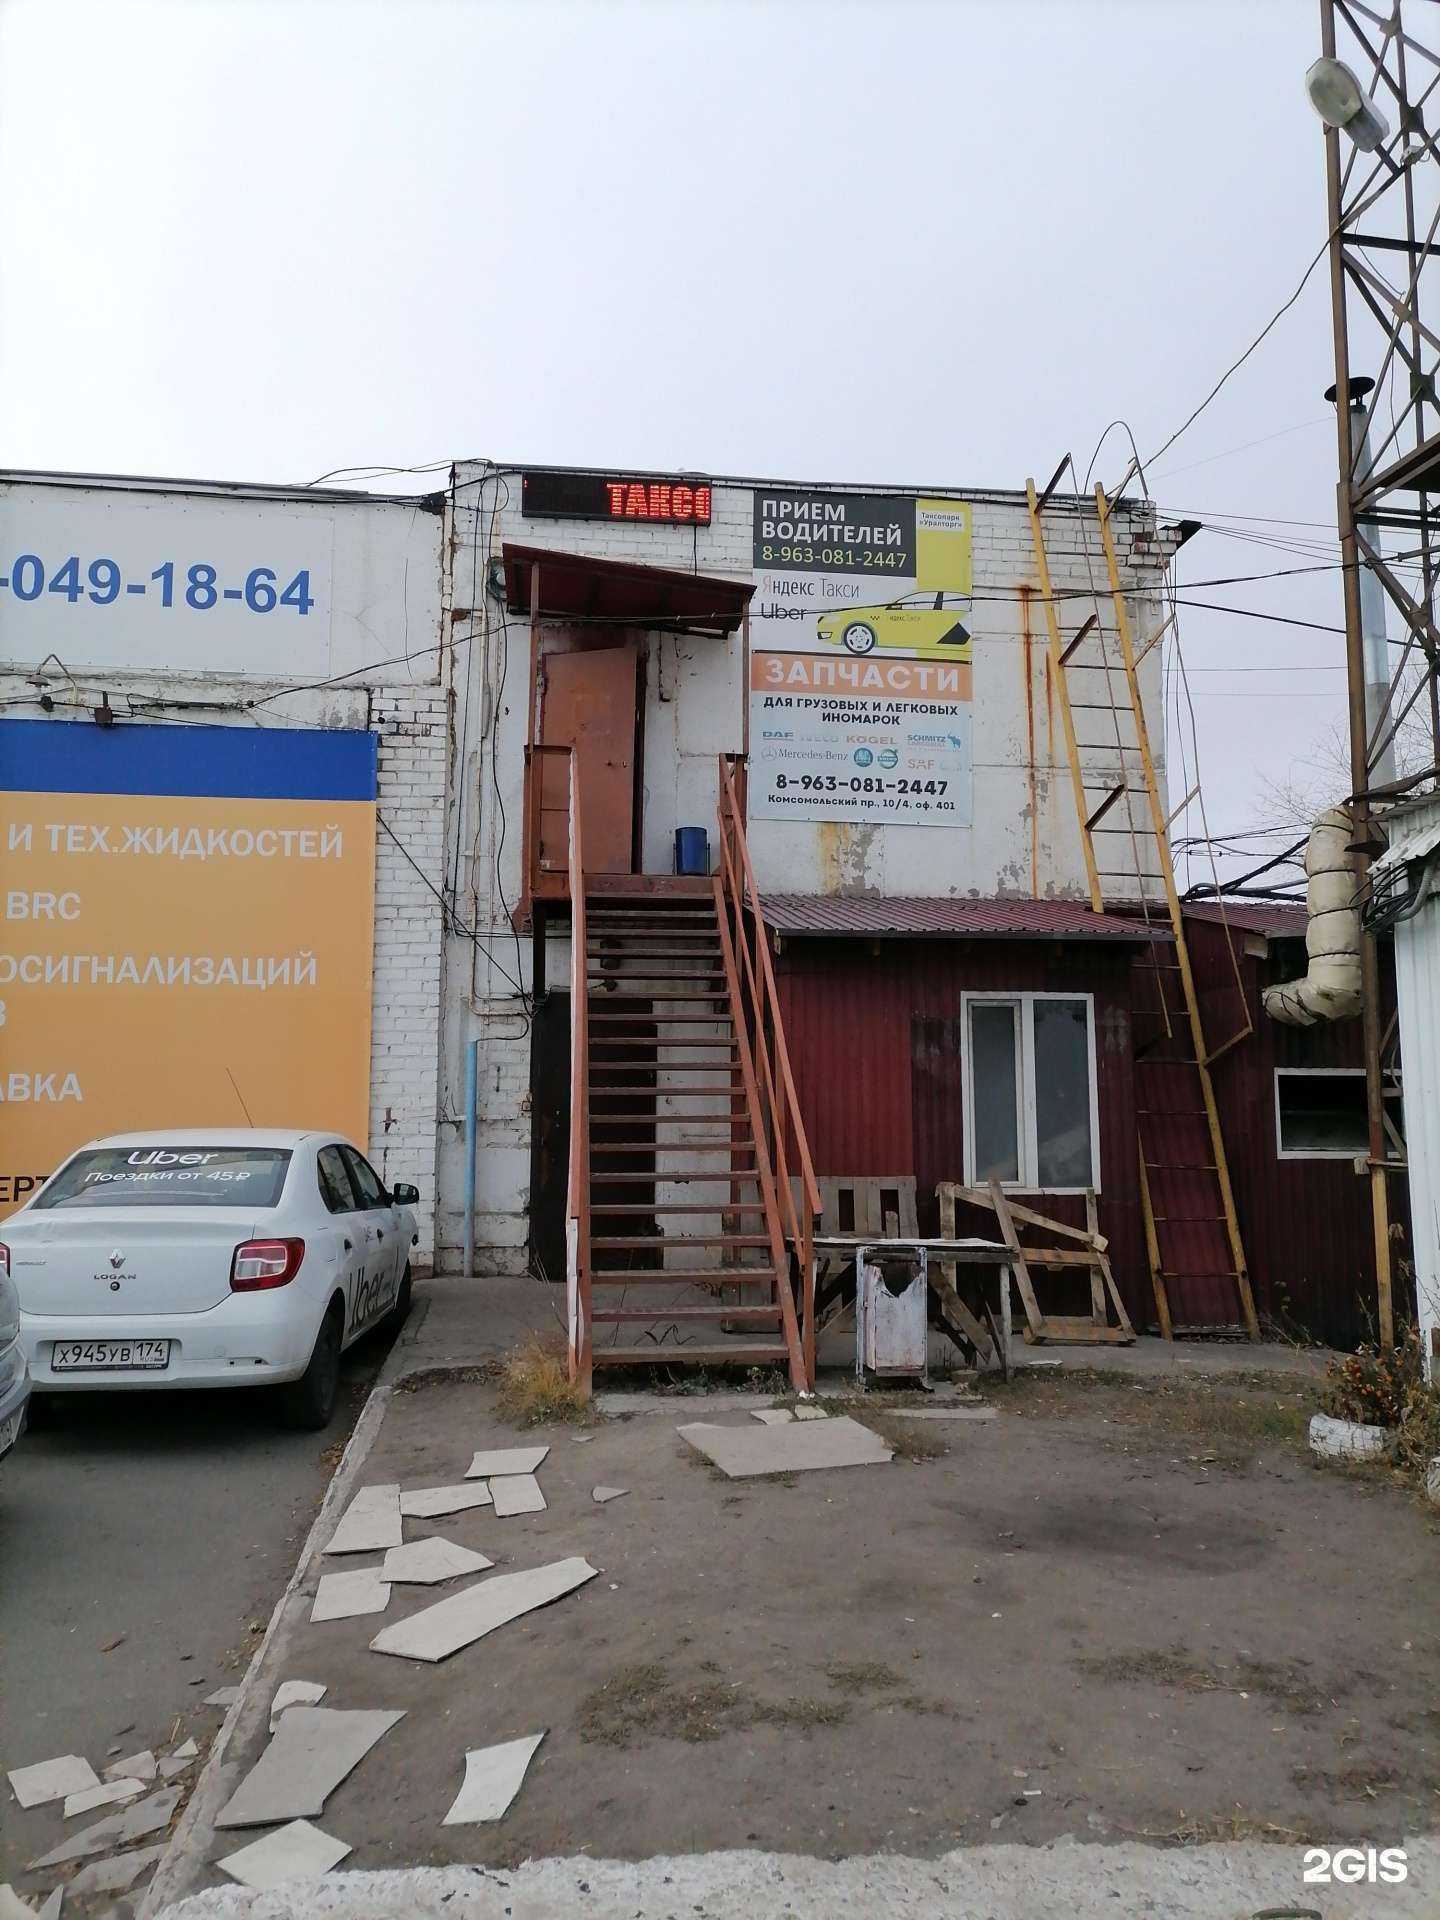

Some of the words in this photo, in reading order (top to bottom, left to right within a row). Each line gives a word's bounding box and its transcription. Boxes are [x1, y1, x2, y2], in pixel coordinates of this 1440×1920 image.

[762, 500, 846, 521] ПРИЕМ
[921, 512, 960, 521] Таксопарк
[762, 521, 902, 546] ВОДИТЕЛЕЙ
[762, 546, 907, 568] 8-963-081-2447
[763, 576, 815, 596] Яндекс
[821, 578, 860, 598] Такси
[761, 603, 808, 621] Uber
[765, 659, 959, 692] ЗАПЧАСТИ
[763, 697, 793, 709] ДЛЯ
[797, 698, 868, 712] ГРУЗОВЫХ
[872, 702, 881, 712] И
[886, 703, 958, 716] ЛЕГКОВЫХ
[822, 712, 900, 725] ИНОМАРОК
[777, 748, 848, 761] Mercedes-Benz
[776, 774, 948, 796] 8-963-081-2447
[768, 794, 858, 807] Комсомольский
[936, 801, 955, 810] 401
[8, 824, 33, 850] И
[45, 824, 344, 860] ТЕХ.ЖИДКОСТЕЙ
[7, 892, 81, 920] BRC
[0, 950, 318, 989] ОСИГНАЛИЗАЦИЙ
[0, 1073, 83, 1102] ВКА
[127, 1151, 219, 1166] Uber
[85, 1171, 174, 1184] Поездки
[177, 1172, 203, 1181] от
[58, 1344, 131, 1364] Х945УВ
[136, 1342, 163, 1358] 174
